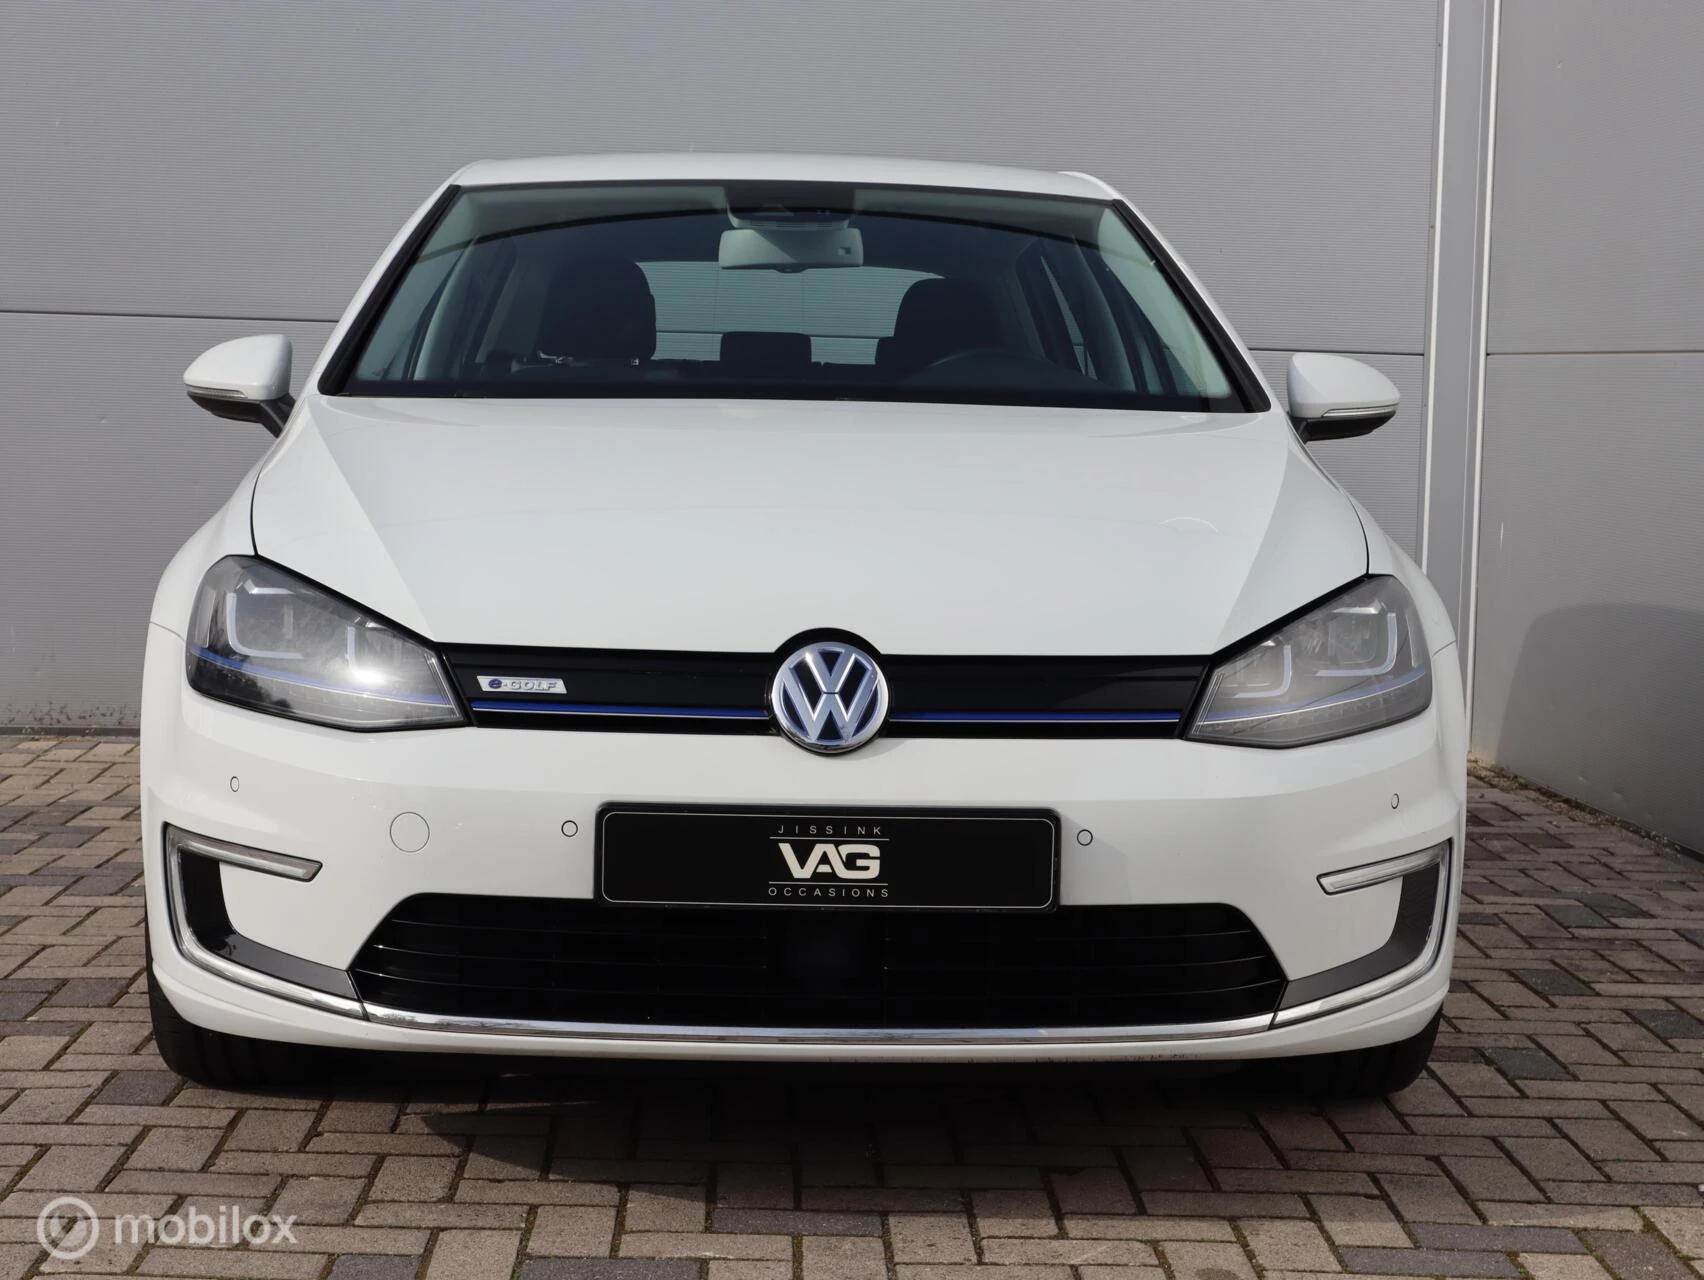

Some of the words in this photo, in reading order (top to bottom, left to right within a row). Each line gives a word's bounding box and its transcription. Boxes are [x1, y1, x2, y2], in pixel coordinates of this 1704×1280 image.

[776, 643, 883, 748] VW
[778, 825, 881, 835] JISSINK
[778, 842, 881, 879] VAG
[768, 887, 889, 897] OCCASIONS
